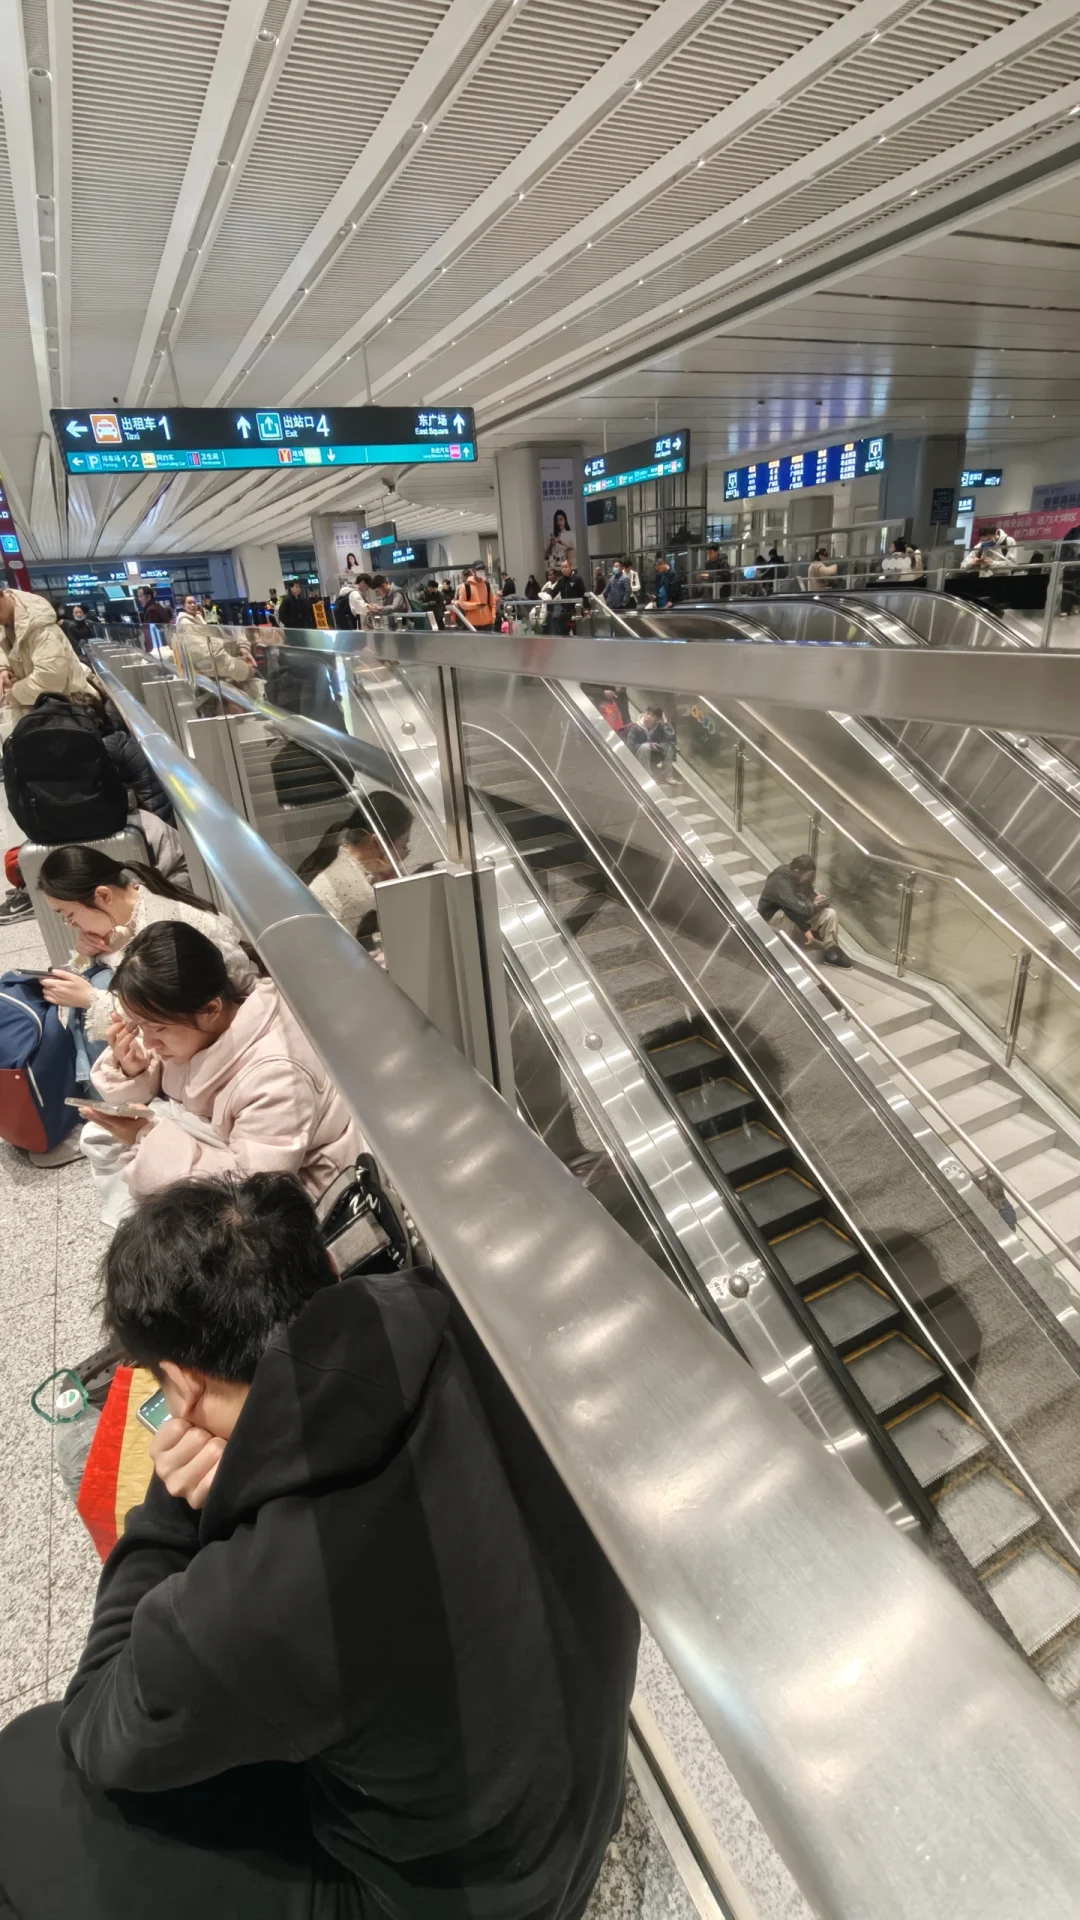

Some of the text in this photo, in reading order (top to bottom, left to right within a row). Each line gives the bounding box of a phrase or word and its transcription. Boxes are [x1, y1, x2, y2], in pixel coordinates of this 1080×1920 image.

[418, 414, 448, 427] 东广场
[121, 415, 171, 441] 出租车 1
[283, 414, 330, 438] 出站口 4
[124, 432, 141, 440] Taxi
[285, 429, 298, 438] Exit
[415, 427, 449, 436] East Square
[101, 454, 121, 462] 停车场
